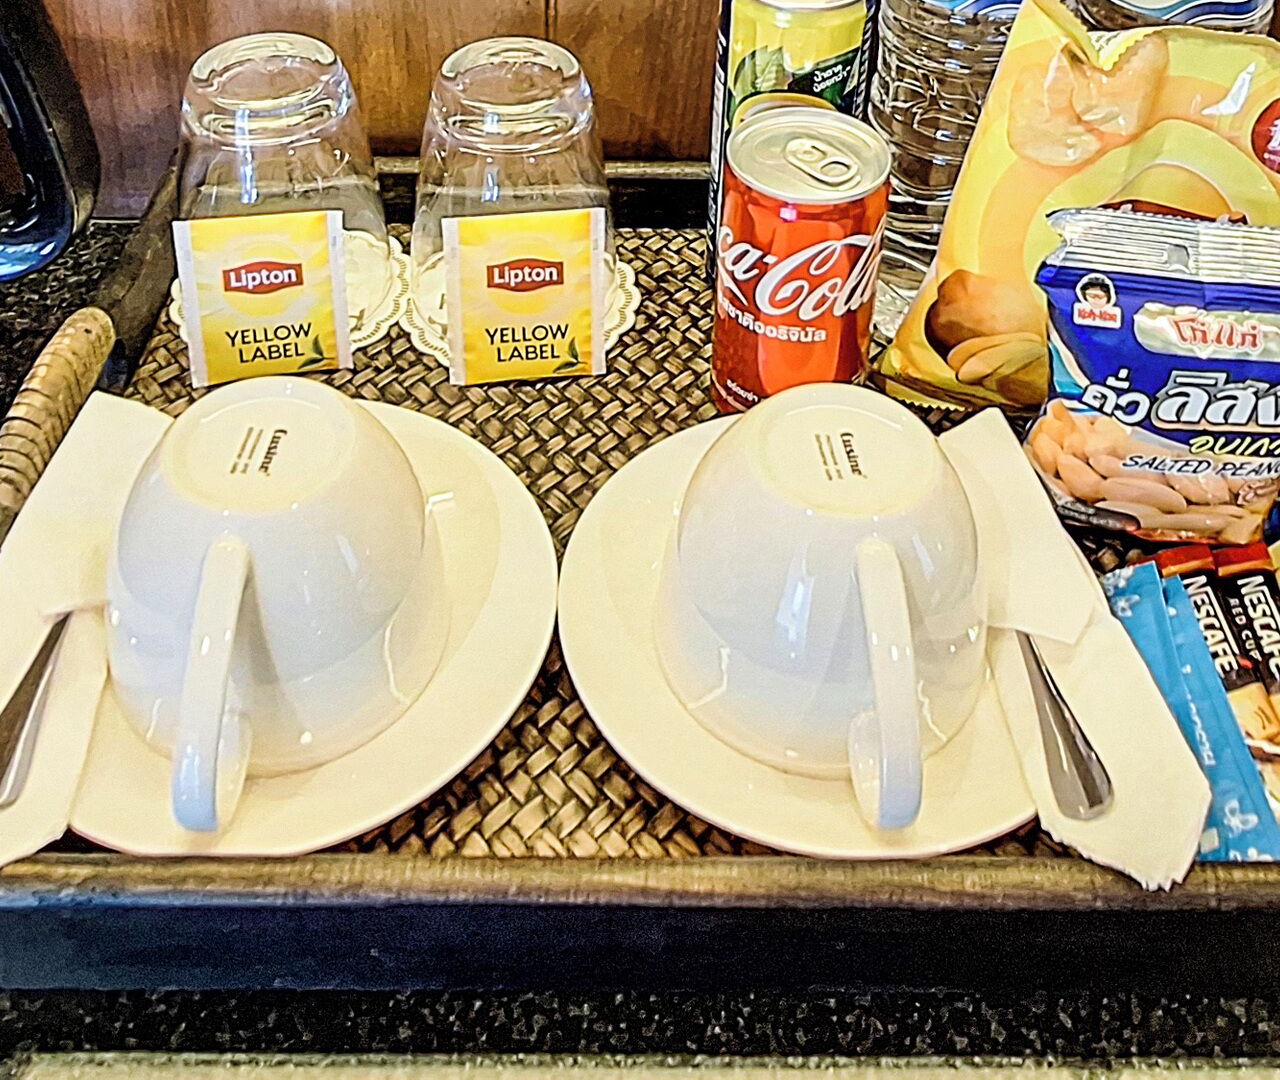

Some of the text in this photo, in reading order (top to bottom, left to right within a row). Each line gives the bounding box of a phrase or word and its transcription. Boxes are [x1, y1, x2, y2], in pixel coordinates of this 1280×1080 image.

[229, 268, 298, 291] Lipton
[493, 265, 559, 288] Lipton
[225, 322, 312, 348] YELLOW
[485, 323, 569, 345] YELLOW
[238, 342, 305, 364] LABEL
[496, 344, 561, 363] LABEL
[1121, 454, 1212, 475] SALTED
[1229, 597, 1263, 663] RED CUP
